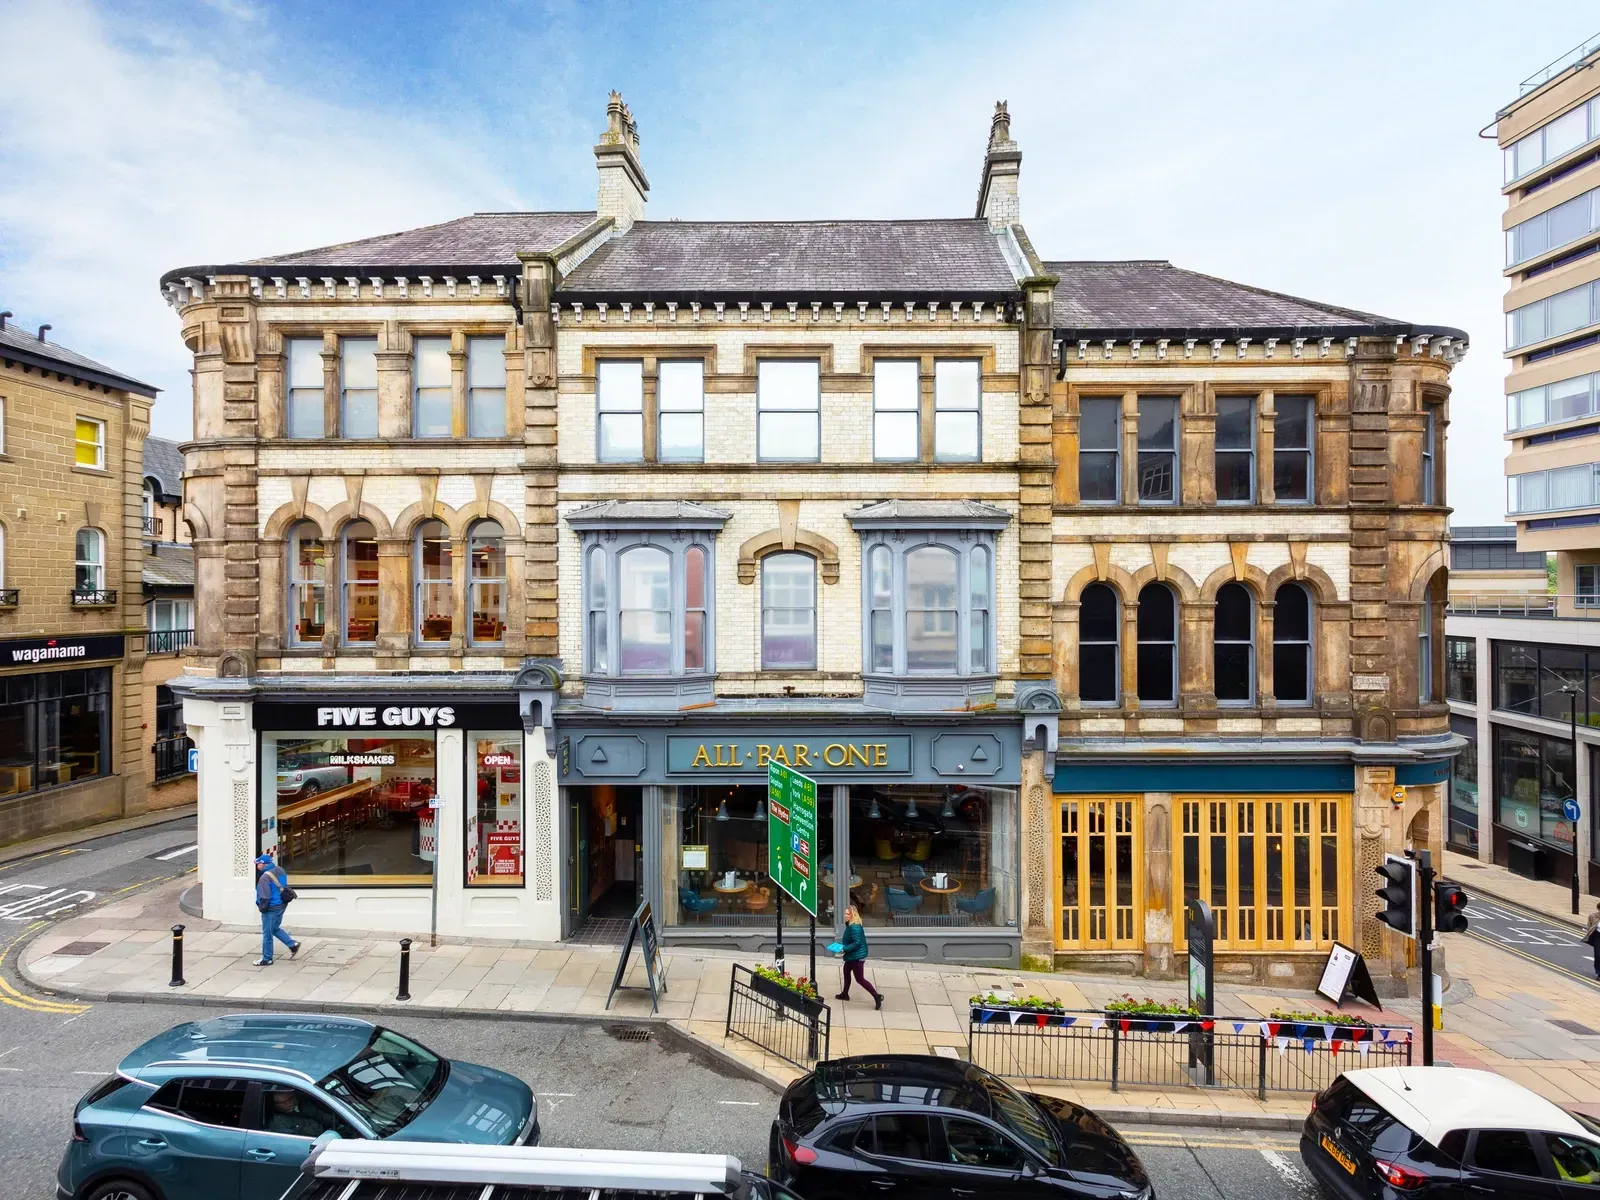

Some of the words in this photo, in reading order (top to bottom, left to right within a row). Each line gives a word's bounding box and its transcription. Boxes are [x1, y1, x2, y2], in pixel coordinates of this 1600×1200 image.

[12, 645, 86, 663] wagamama
[317, 706, 377, 726] FIVE
[382, 706, 456, 726] GUYS
[329, 755, 395, 765] MILKSHAKES
[484, 755, 511, 765] OPEN
[691, 744, 743, 767] ALL
[755, 744, 812, 767] BAR
[823, 743, 889, 767] ONE
[792, 776, 803, 789] Leeds
[793, 801, 813, 820] Harrogate
[792, 810, 814, 831] Convention
[795, 823, 810, 839] Centre
[793, 833, 799, 848] P
